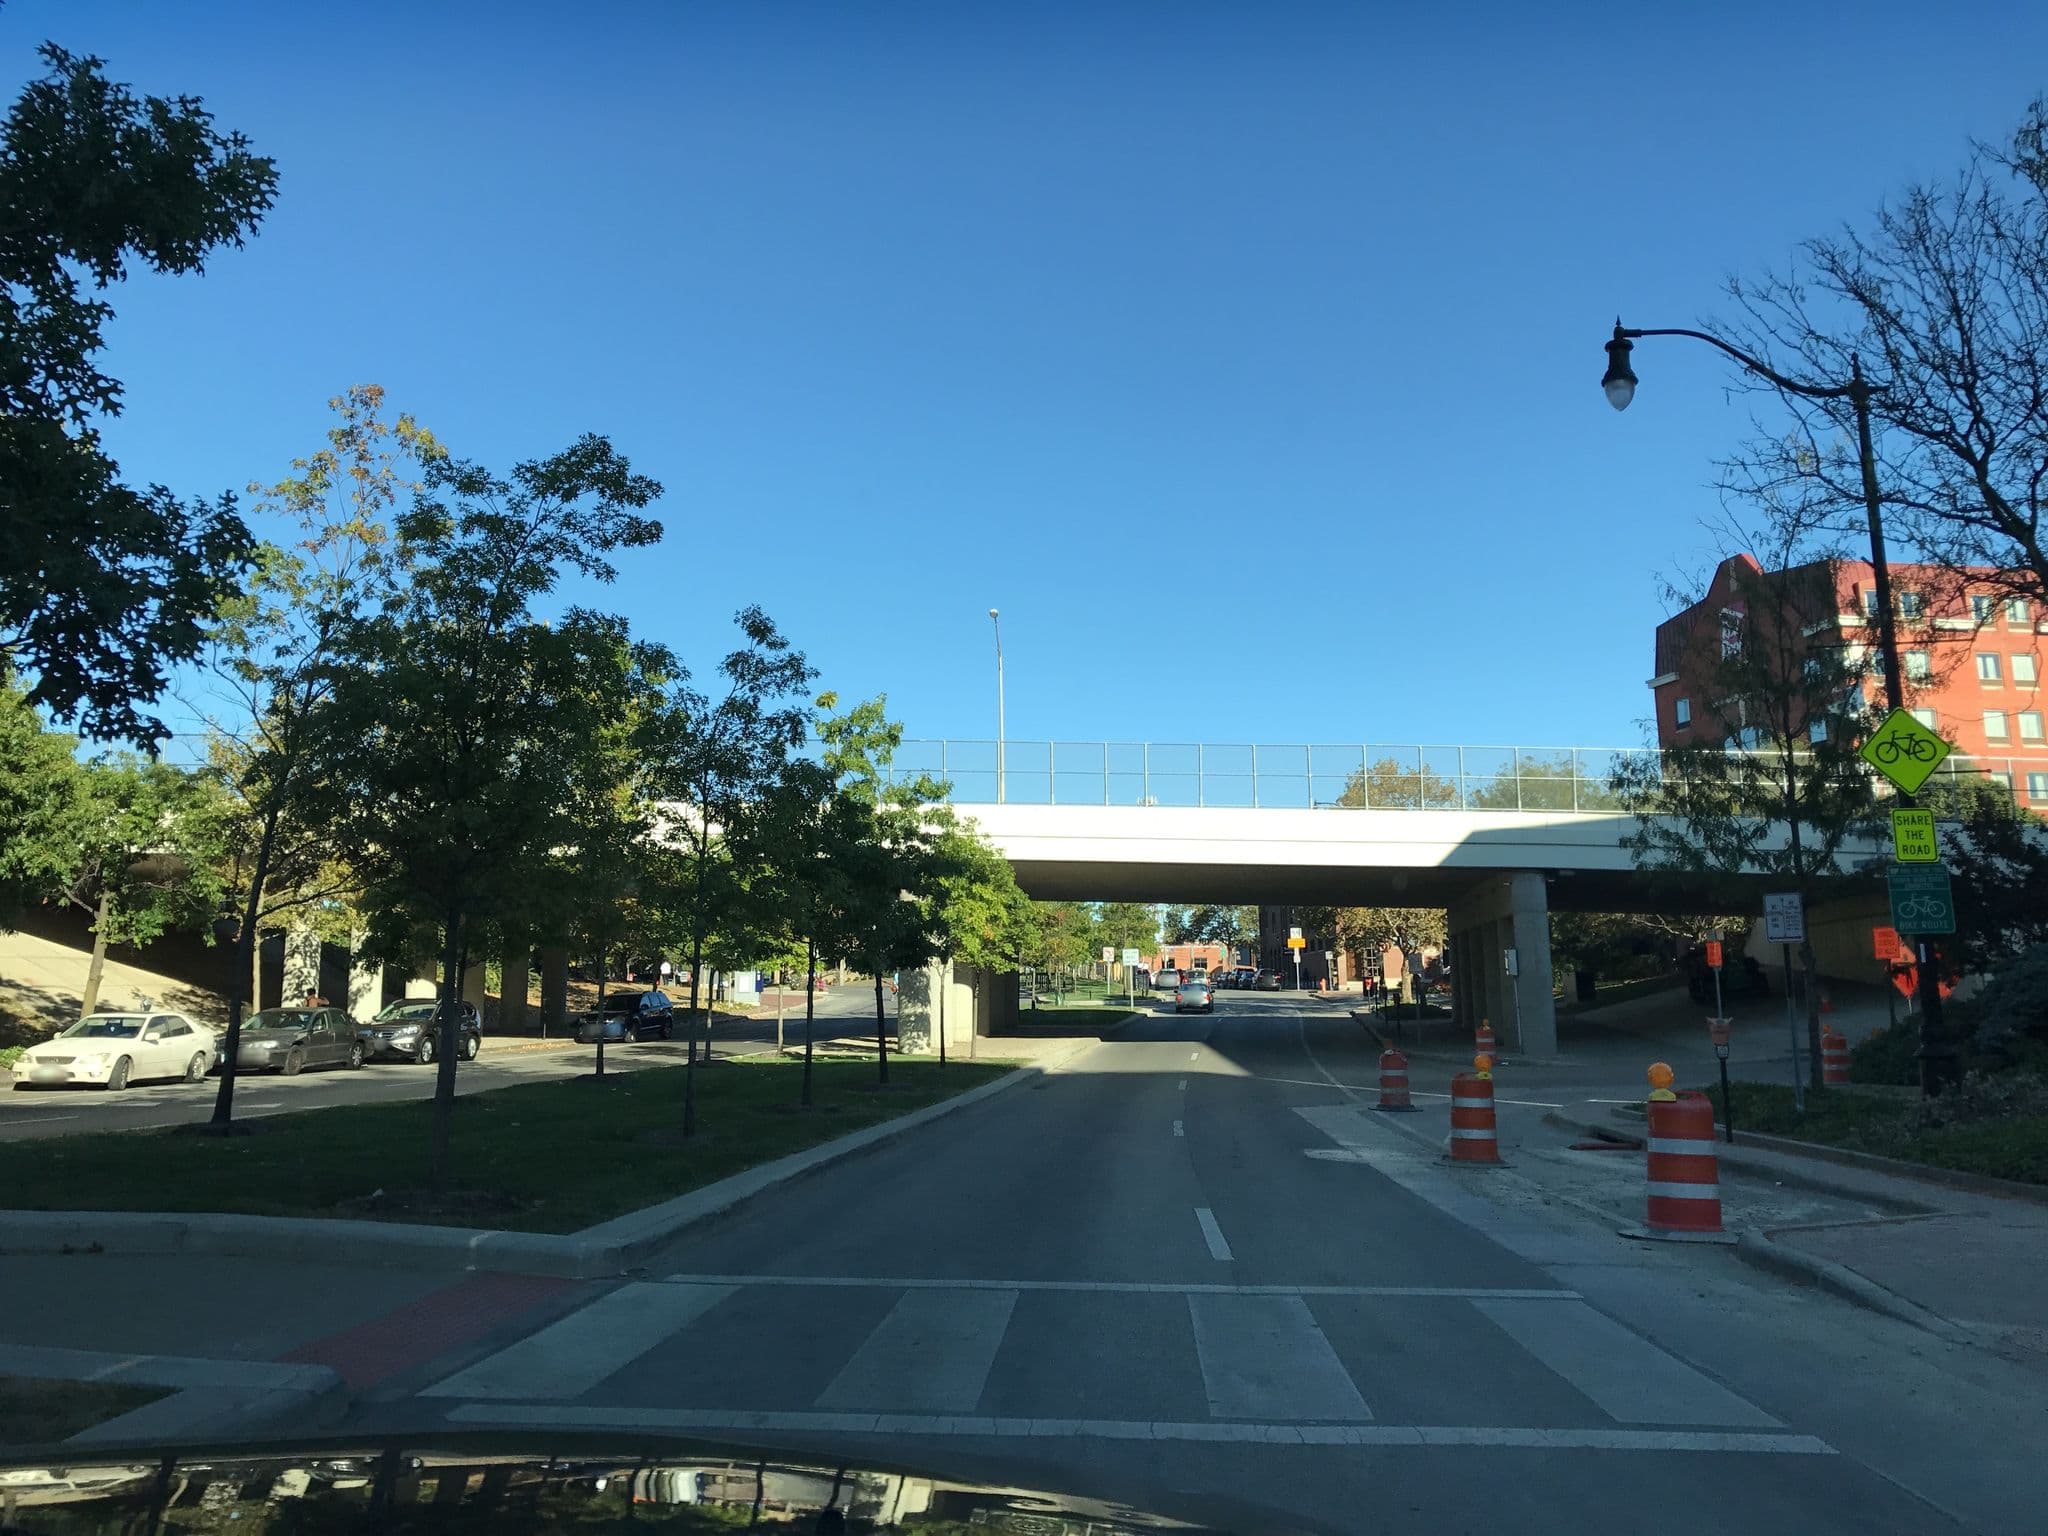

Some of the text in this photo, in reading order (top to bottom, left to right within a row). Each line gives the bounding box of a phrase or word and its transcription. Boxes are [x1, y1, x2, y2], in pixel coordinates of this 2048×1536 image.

[1896, 815, 1931, 826] SHARE
[1905, 830, 1925, 840] THE
[1902, 844, 1931, 855] ROAD
[1899, 919, 1948, 929] BIKE ROUTE
